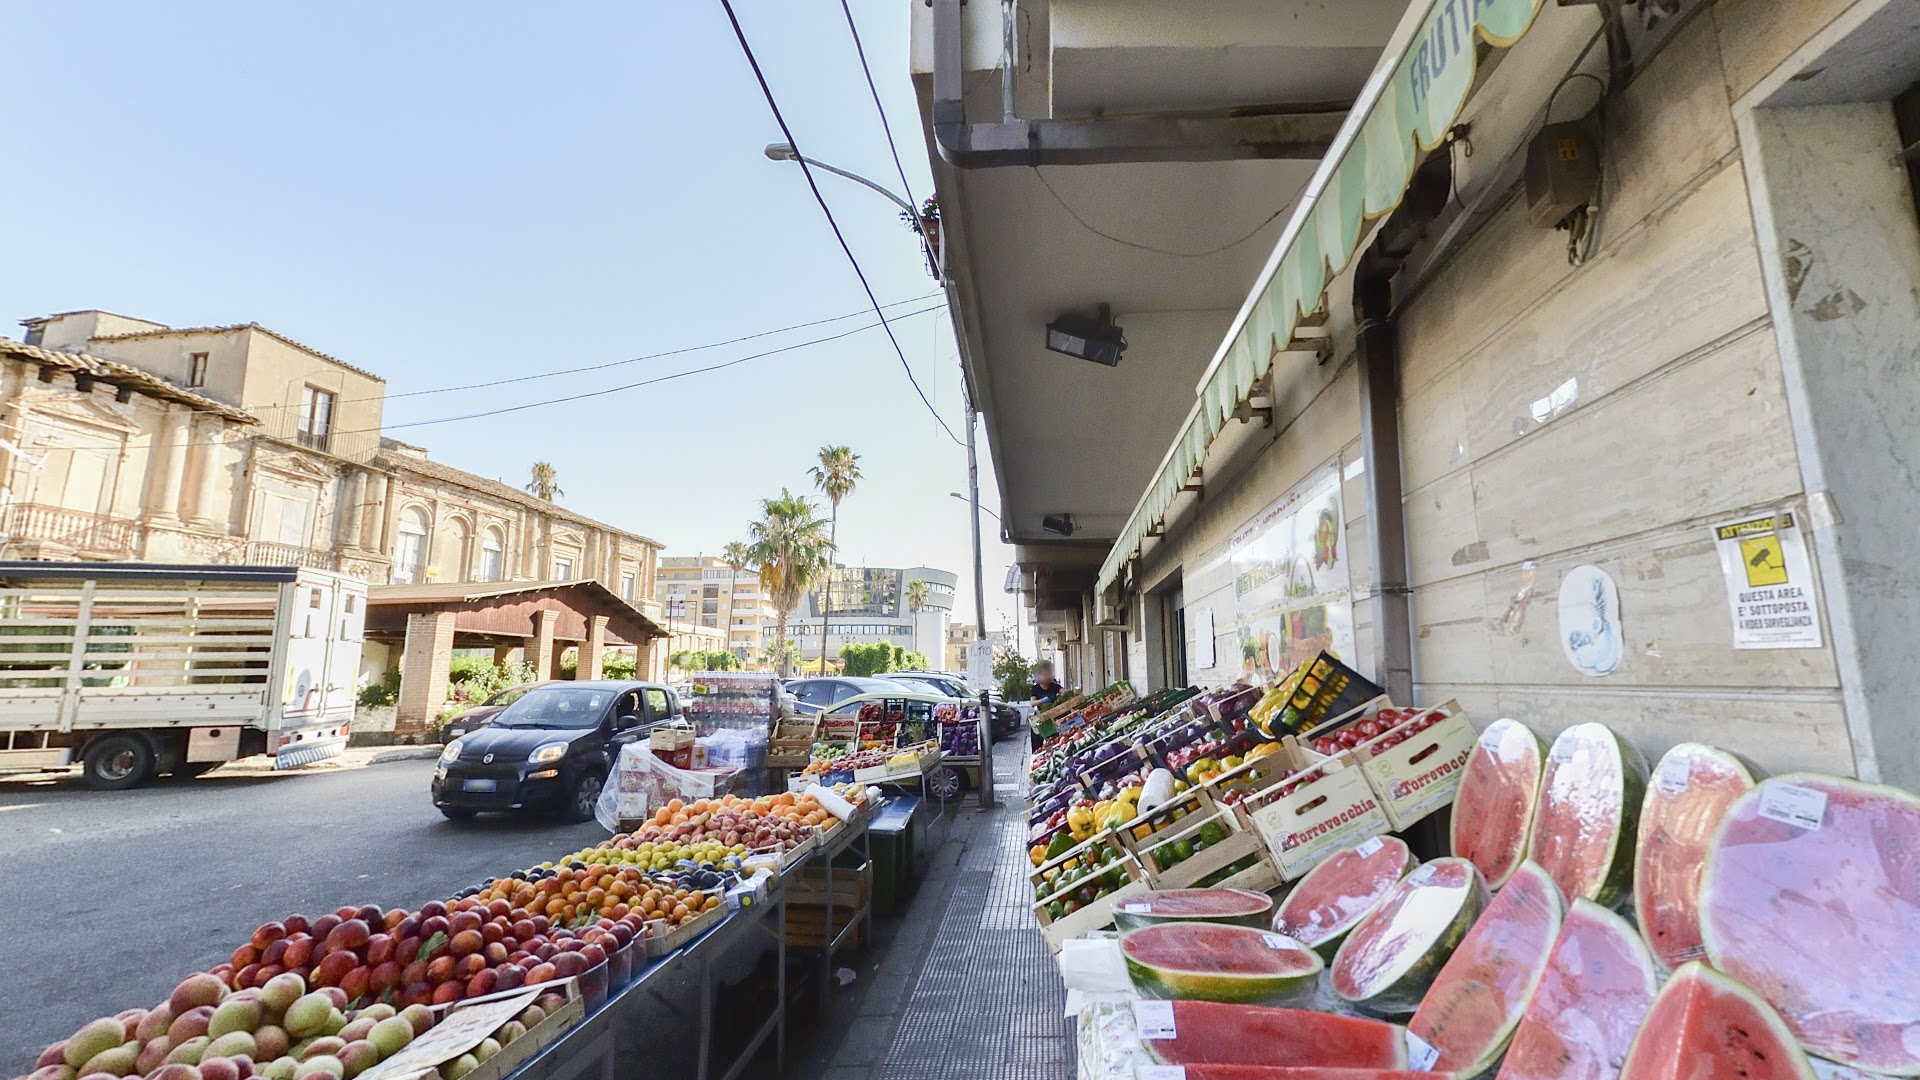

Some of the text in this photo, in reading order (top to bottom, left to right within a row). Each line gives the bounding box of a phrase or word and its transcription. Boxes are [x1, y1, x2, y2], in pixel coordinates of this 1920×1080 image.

[1739, 587, 1804, 603] QUESTA AREA
[1738, 602, 1810, 617] E' SOTTOPOSTA
[1745, 618, 1763, 630] VIDEO
[1764, 616, 1813, 629] SORVEGLIANZA
[1400, 745, 1473, 796] Torrevecch
[1290, 799, 1376, 848] Torrevecchia
